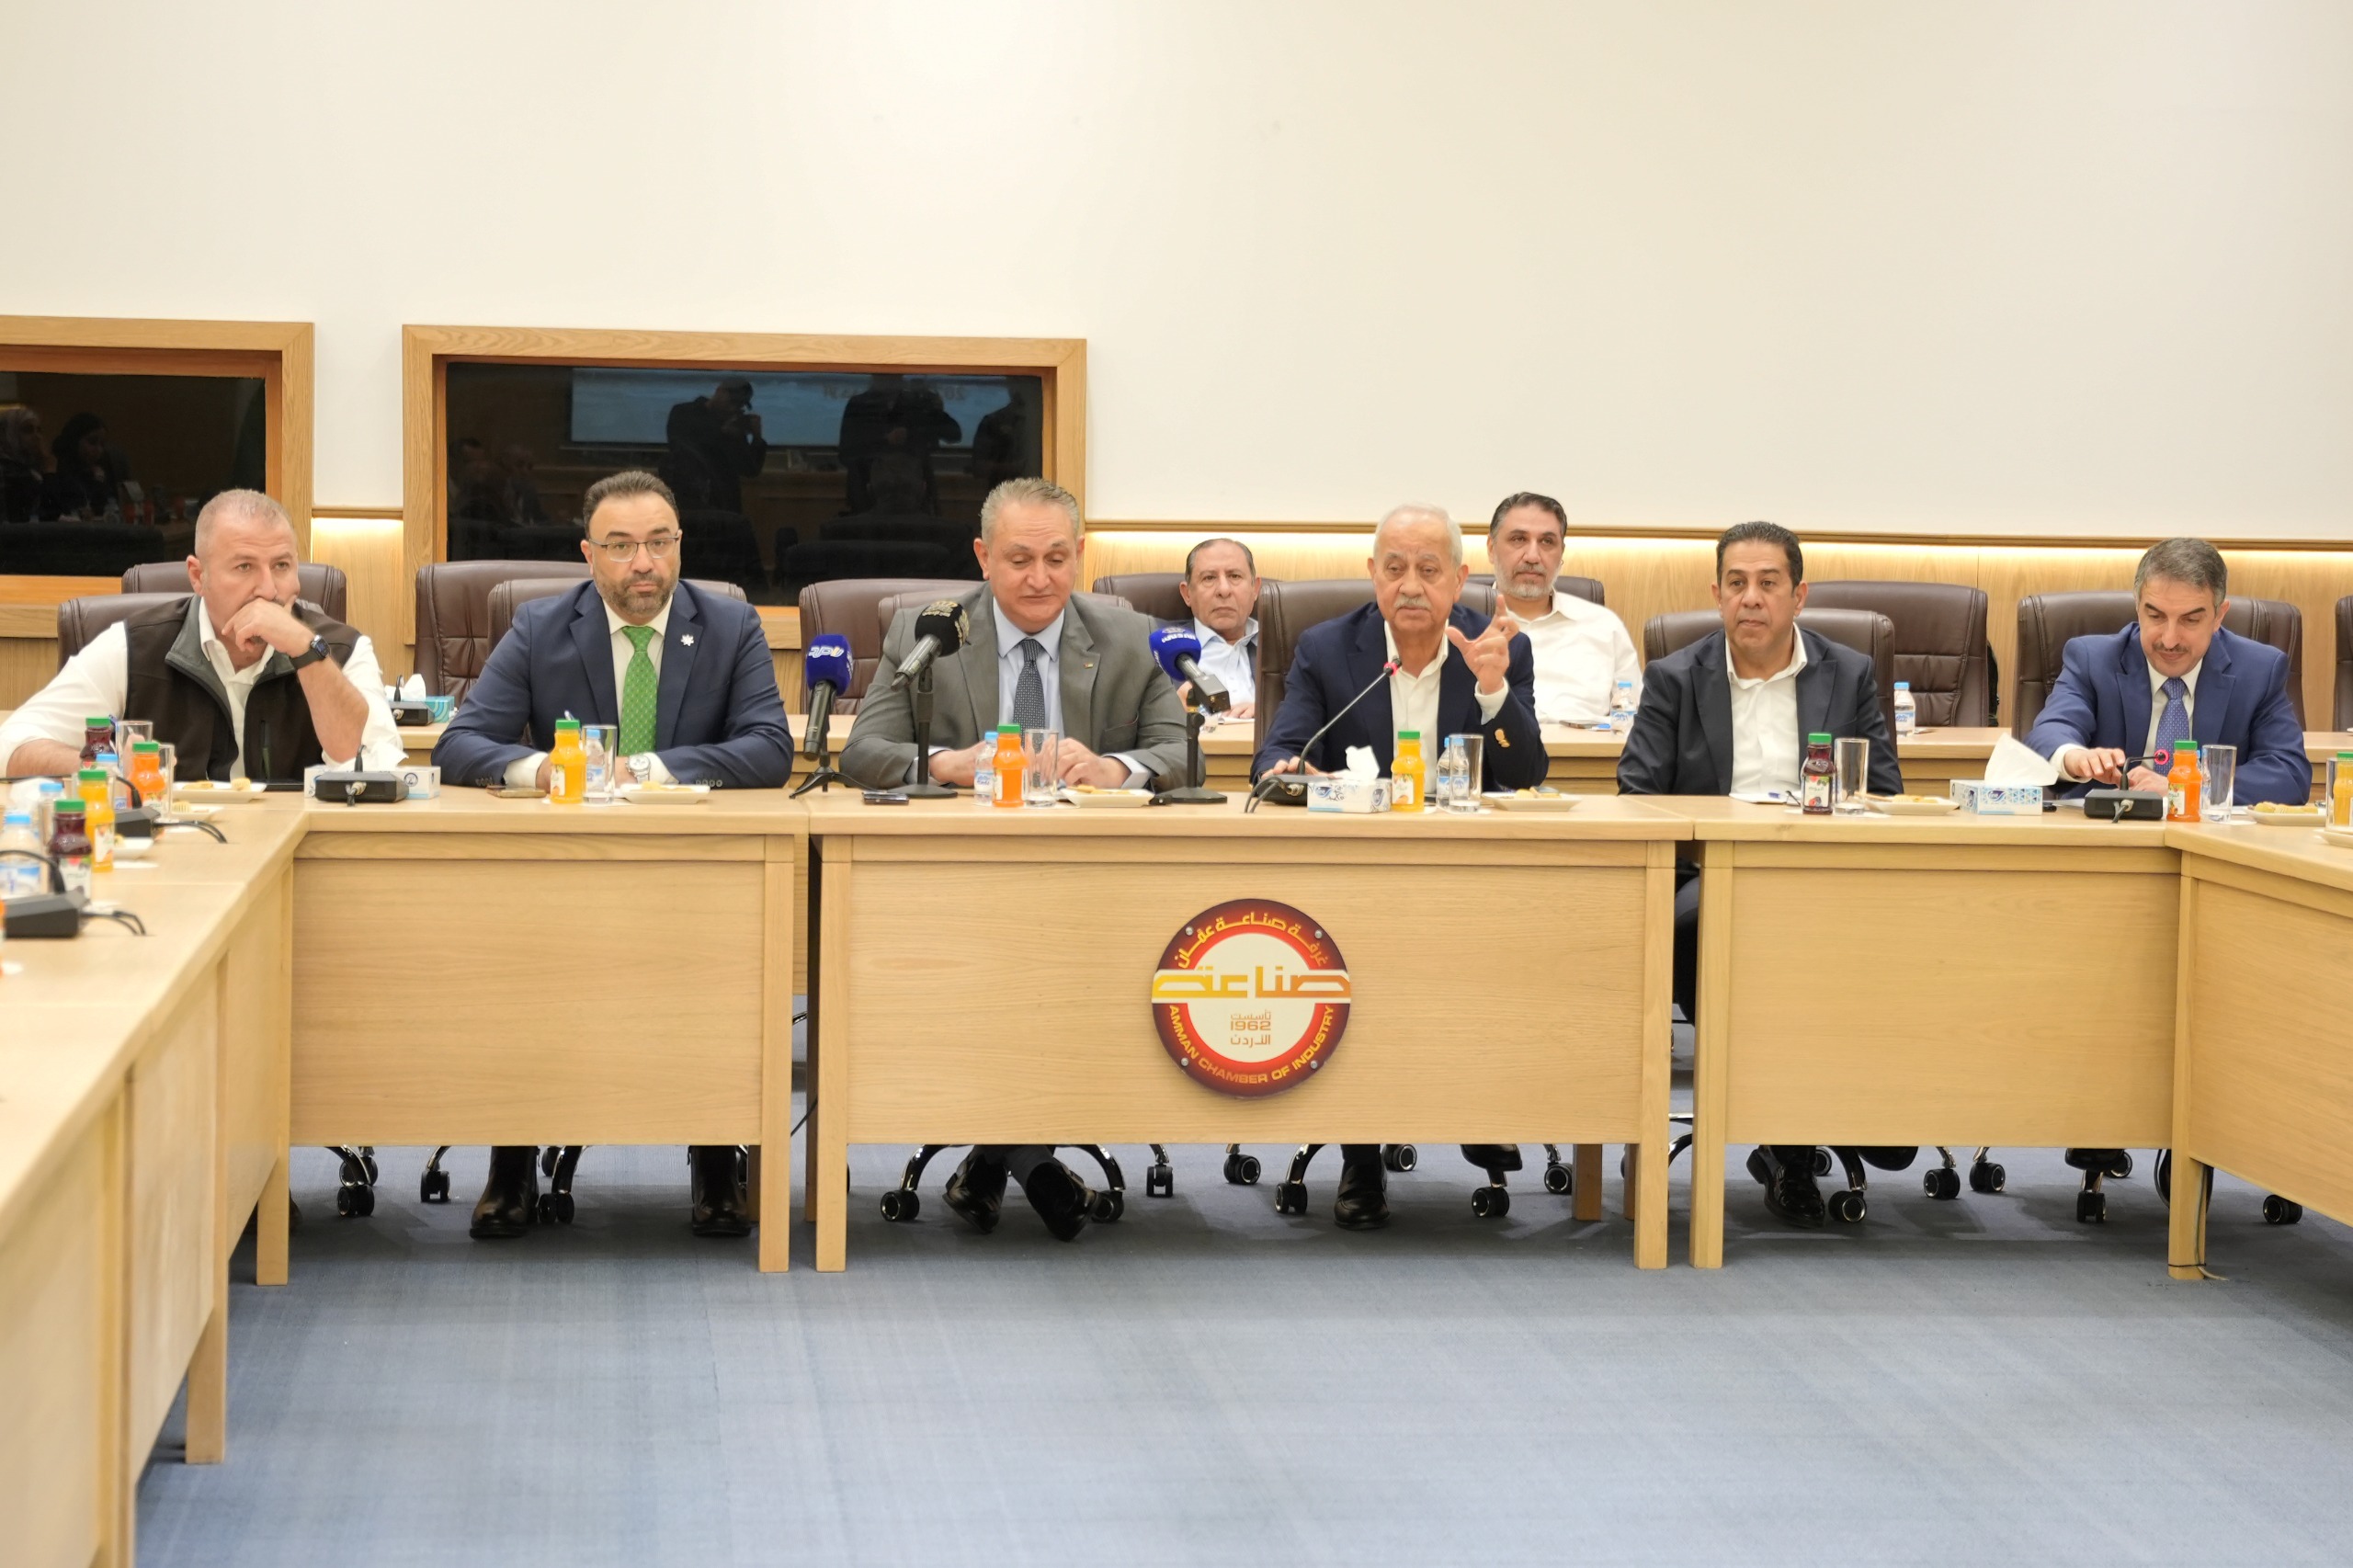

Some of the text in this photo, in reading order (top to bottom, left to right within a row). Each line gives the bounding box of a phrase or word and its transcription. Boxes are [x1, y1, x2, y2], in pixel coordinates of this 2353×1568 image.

[1215, 912, 1287, 932] صناعة
[1288, 923, 1328, 967] غرفة
[1230, 1020, 1271, 1031] 1962
[1169, 1005, 1334, 1085] AMMAN CHAMBER OF INDUSTRY
